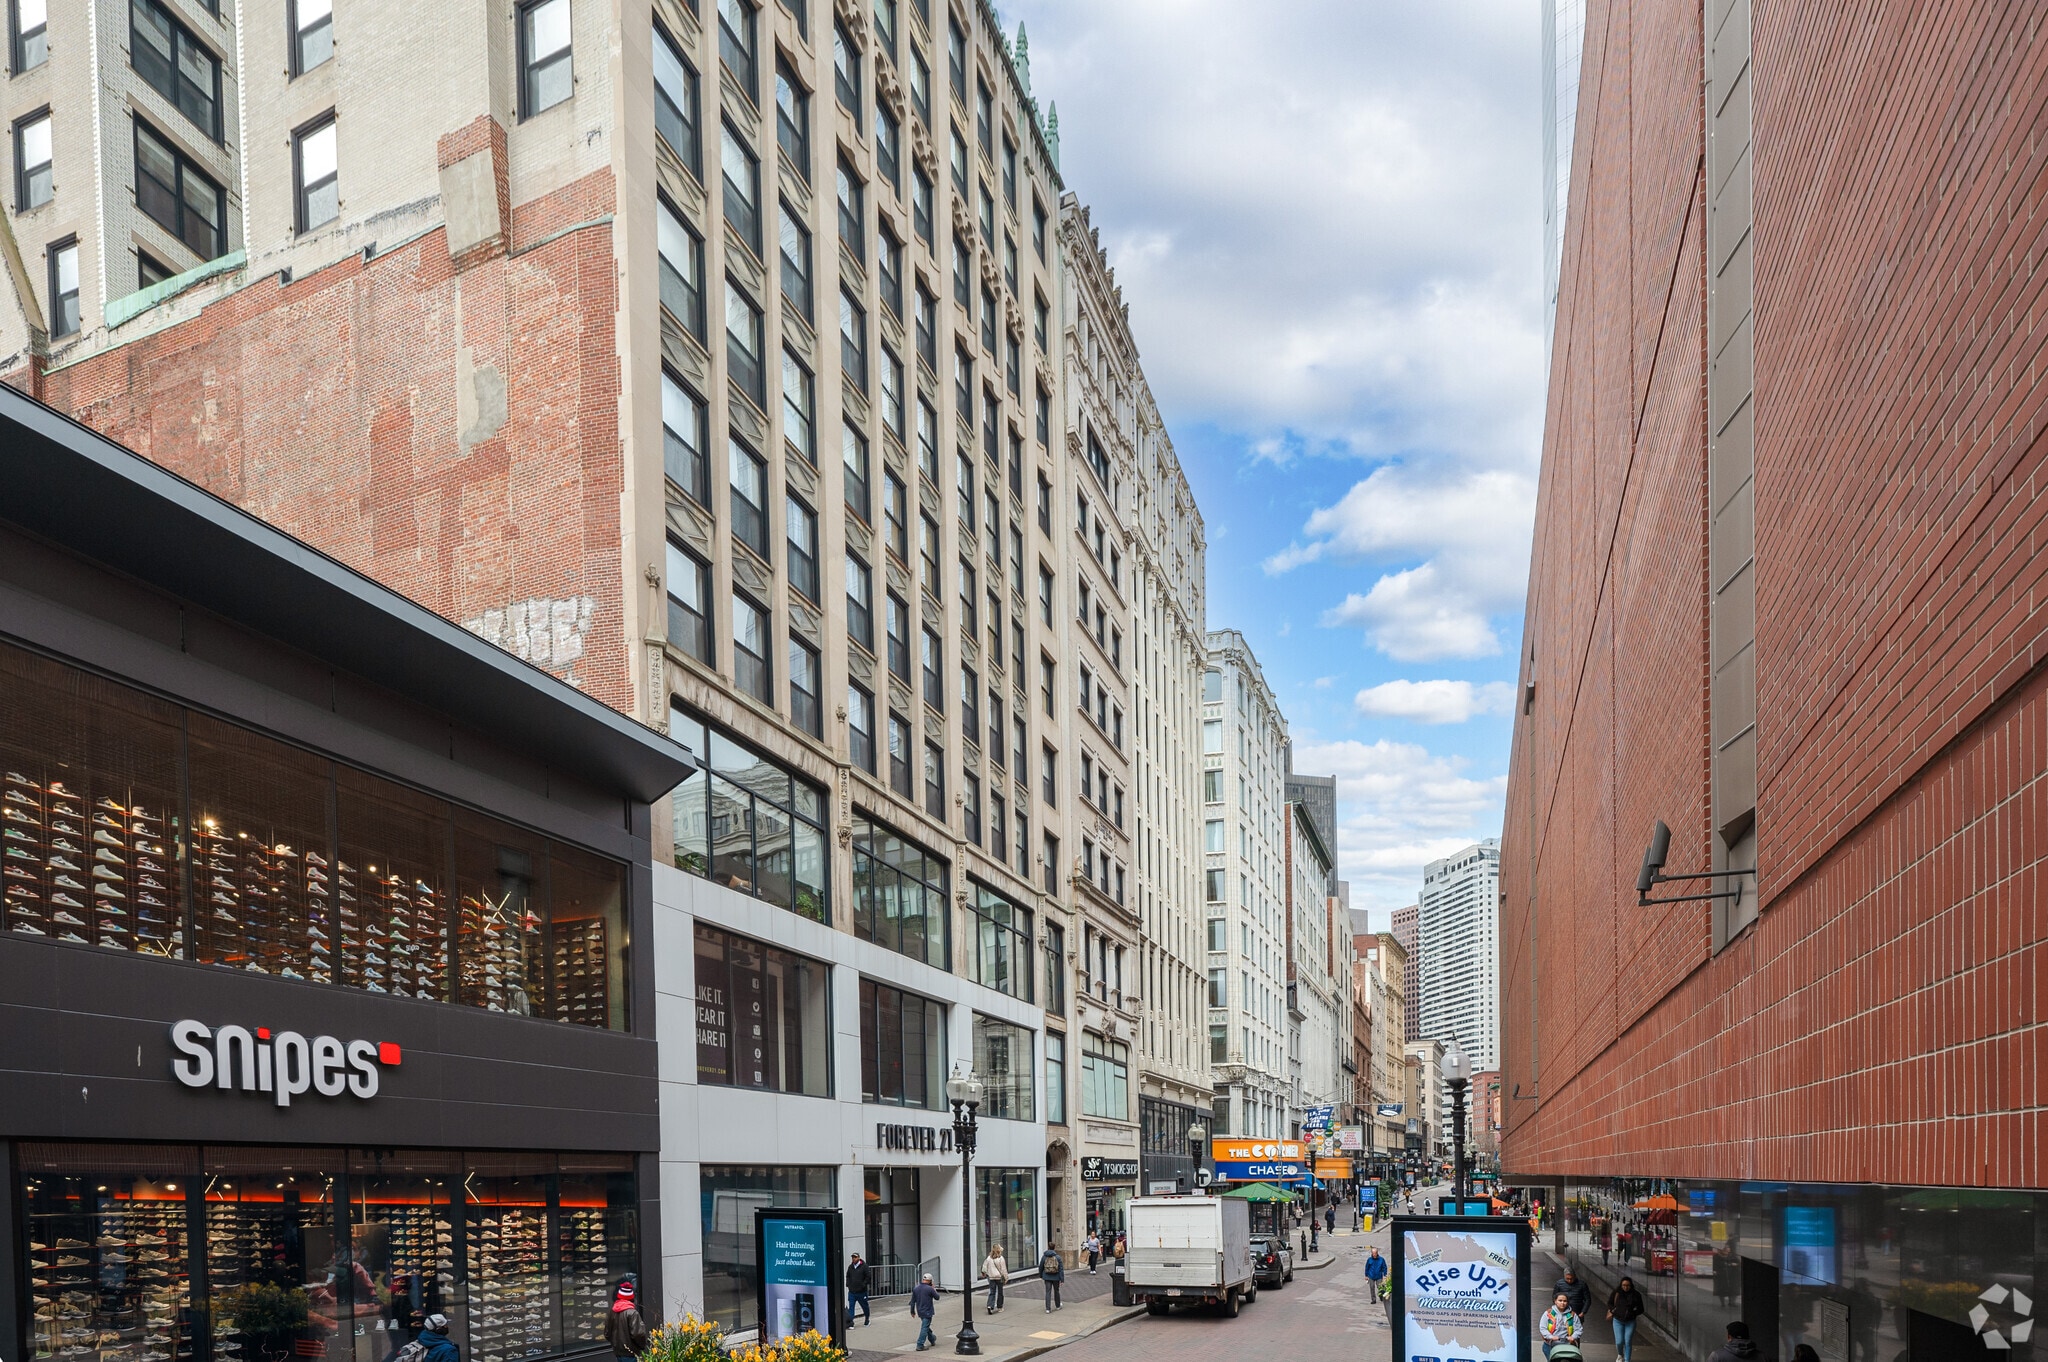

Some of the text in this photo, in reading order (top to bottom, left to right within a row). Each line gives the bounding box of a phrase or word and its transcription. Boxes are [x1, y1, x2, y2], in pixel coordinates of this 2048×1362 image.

[714, 990, 724, 1006] IT.
[718, 1011, 725, 1026] IT
[696, 1028, 726, 1048] HARE IT
[170, 1019, 379, 1106] snipes
[697, 1066, 726, 1074] OREVER21.COM
[876, 1122, 952, 1152] FOREVER 21
[1228, 1144, 1298, 1158] THE CORNER
[1110, 1164, 1126, 1174] SMOKE
[1126, 1164, 1138, 1174] SHOP
[1249, 1166, 1288, 1175] CHASE
[1198, 1174, 1208, 1184] T
[789, 1242, 814, 1251] thinning
[1488, 1252, 1510, 1267] FREE!
[1416, 1264, 1508, 1294] Rise Up!
[1438, 1287, 1481, 1298] for youth
[1418, 1297, 1505, 1311] Mental Health
